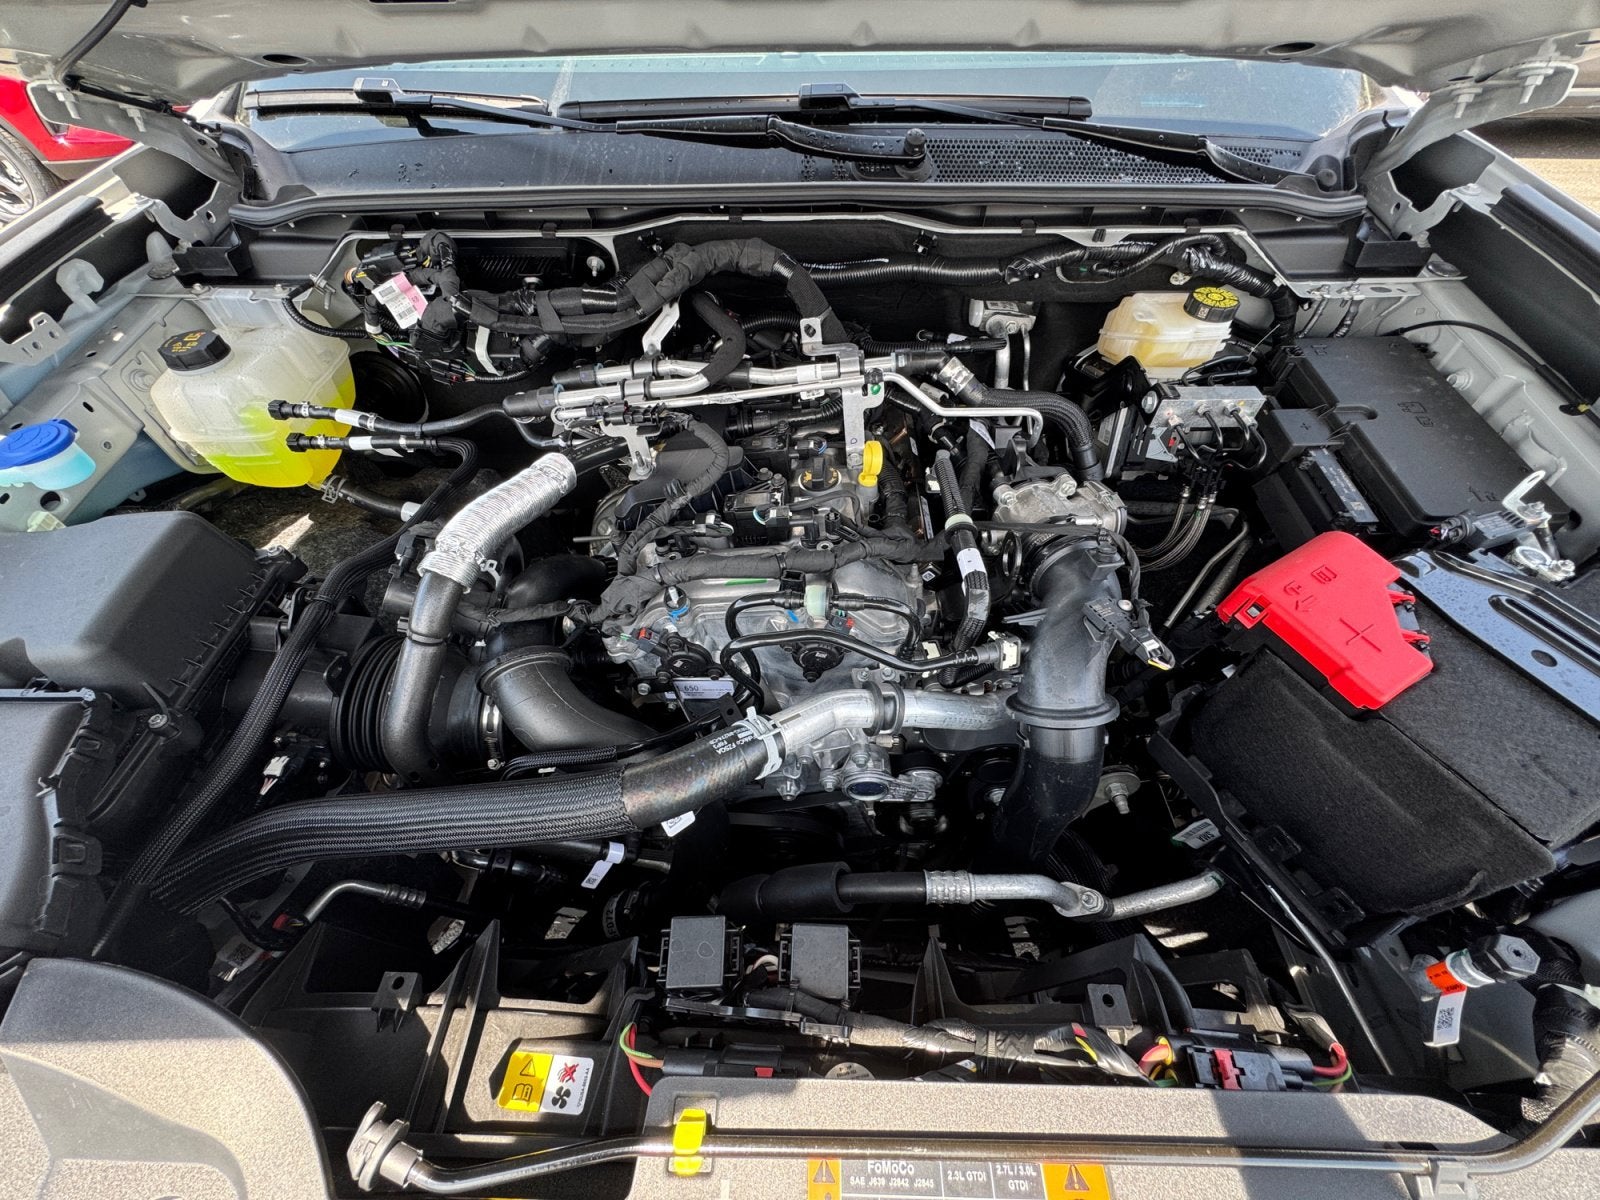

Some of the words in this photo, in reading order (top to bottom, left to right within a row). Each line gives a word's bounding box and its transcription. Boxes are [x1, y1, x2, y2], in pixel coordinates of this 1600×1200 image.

[867, 1160, 915, 1175] FoMoCo
[996, 1164, 1013, 1175] 2.7L
[849, 1176, 866, 1186] SAE
[966, 1170, 987, 1182] GTDI
[1008, 1179, 1029, 1191] GTDI
